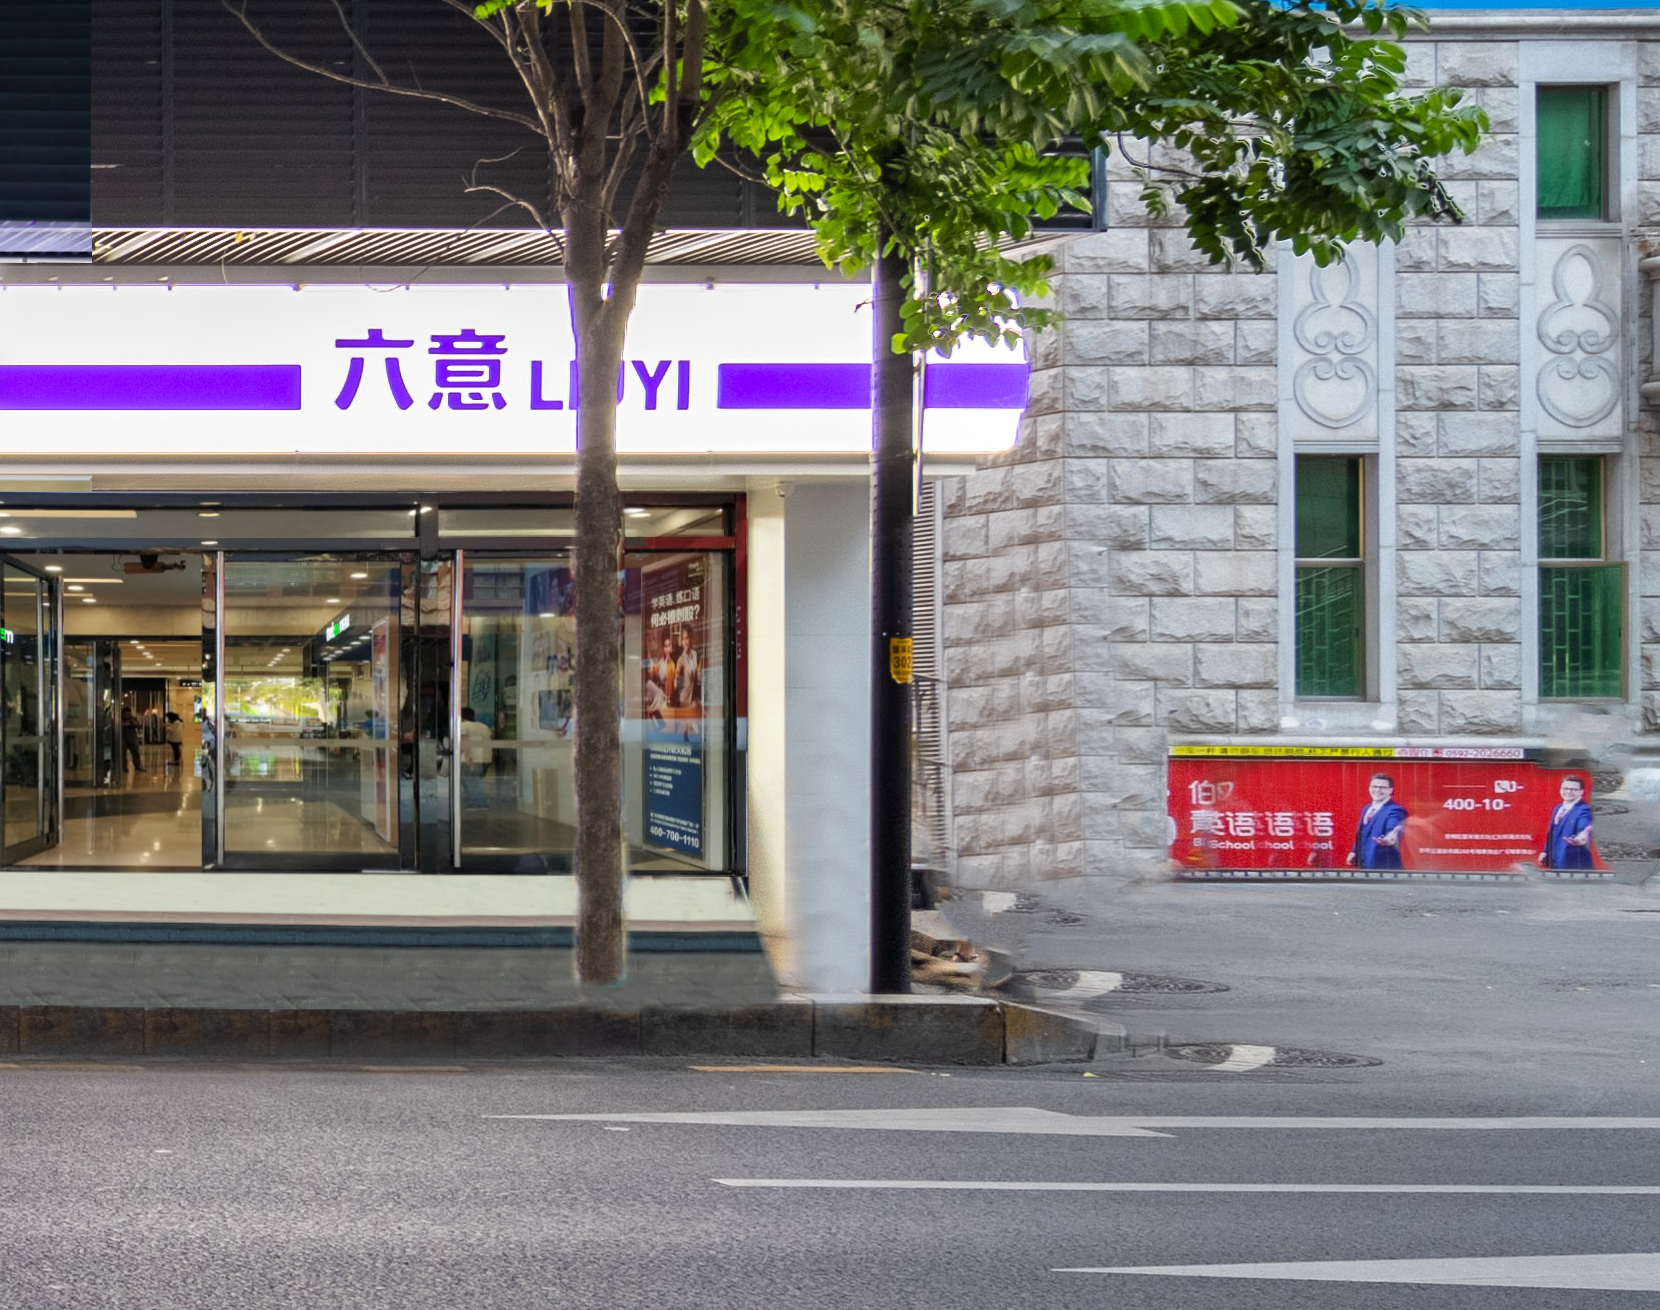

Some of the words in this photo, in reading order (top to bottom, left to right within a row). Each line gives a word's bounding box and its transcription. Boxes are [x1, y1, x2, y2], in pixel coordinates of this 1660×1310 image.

[334, 329, 508, 410] 六意
[530, 360, 691, 411] LIYI
[1446, 748, 1521, 758] 0592-2026660
[649, 825, 699, 849] 400-700-1110
